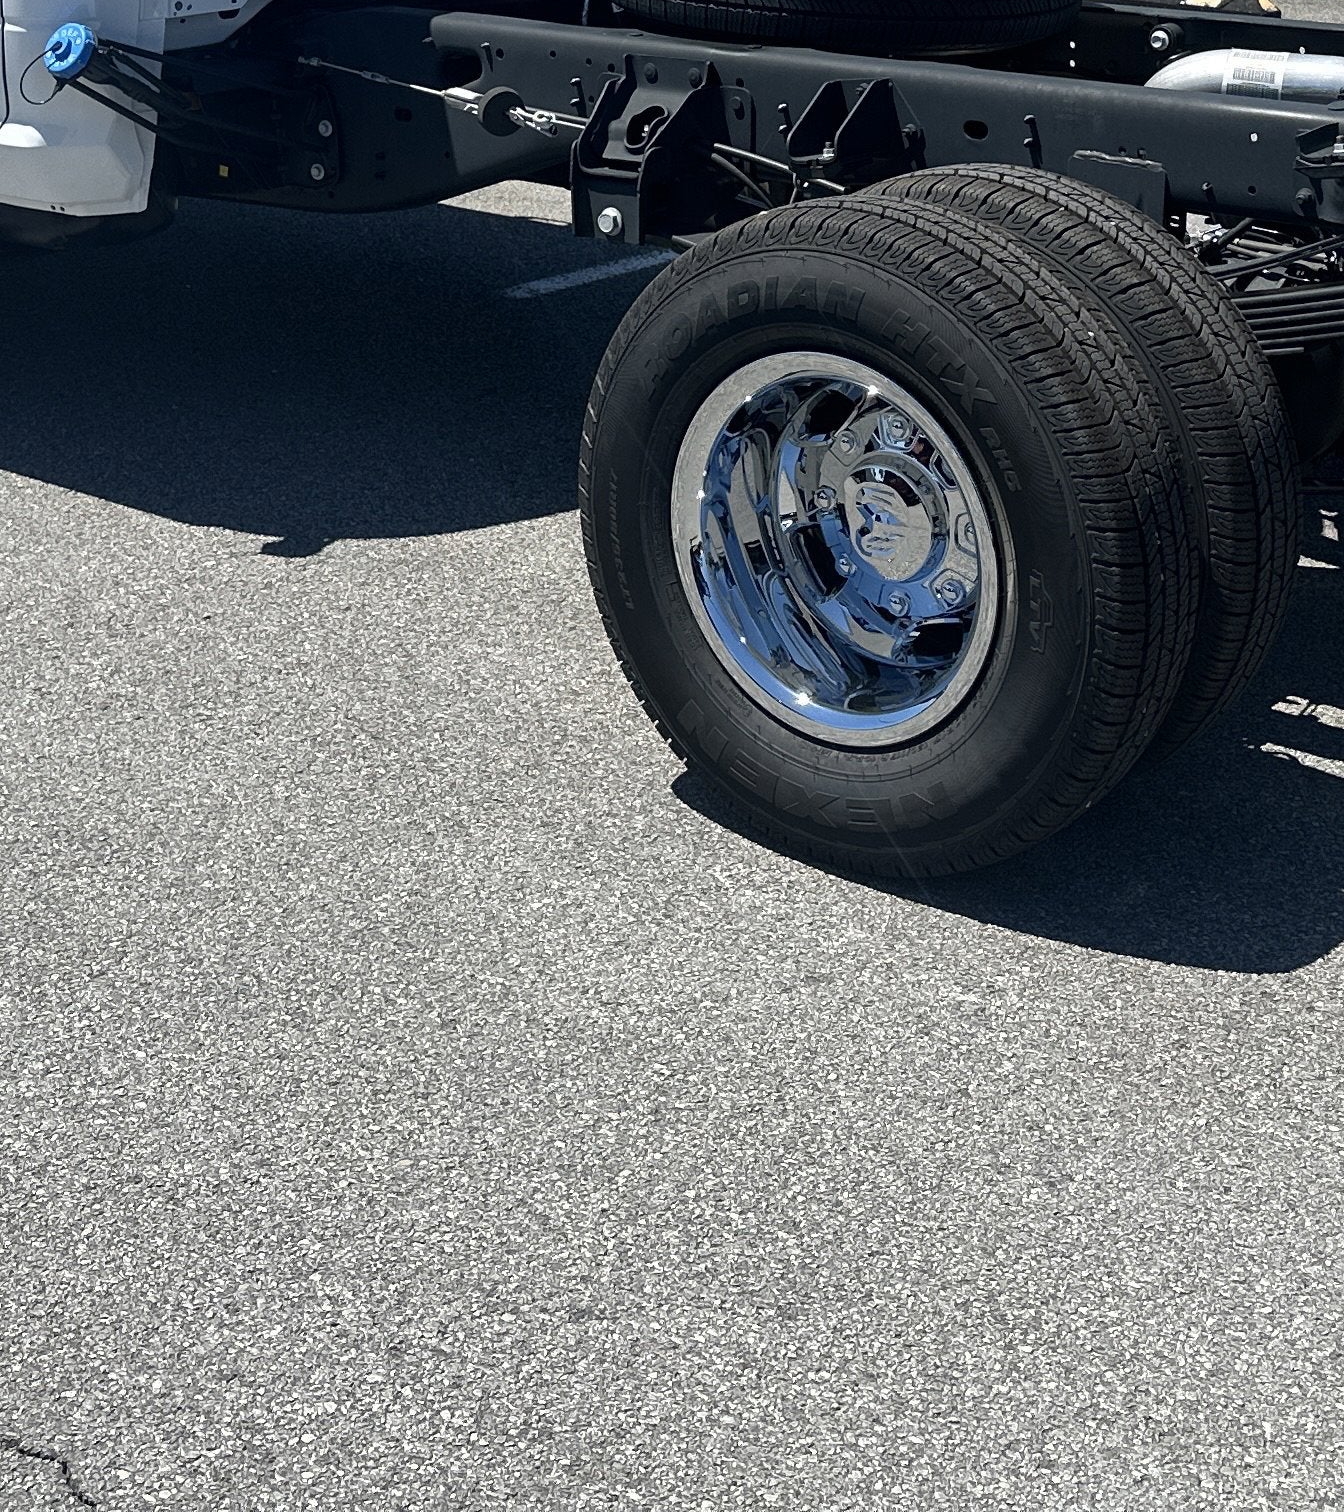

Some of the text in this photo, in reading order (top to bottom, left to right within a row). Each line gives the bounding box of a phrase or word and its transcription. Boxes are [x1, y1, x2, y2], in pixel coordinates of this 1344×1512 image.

[647, 274, 1022, 492] ROADIAN HTX RH5
[675, 698, 959, 831] NEXEN
